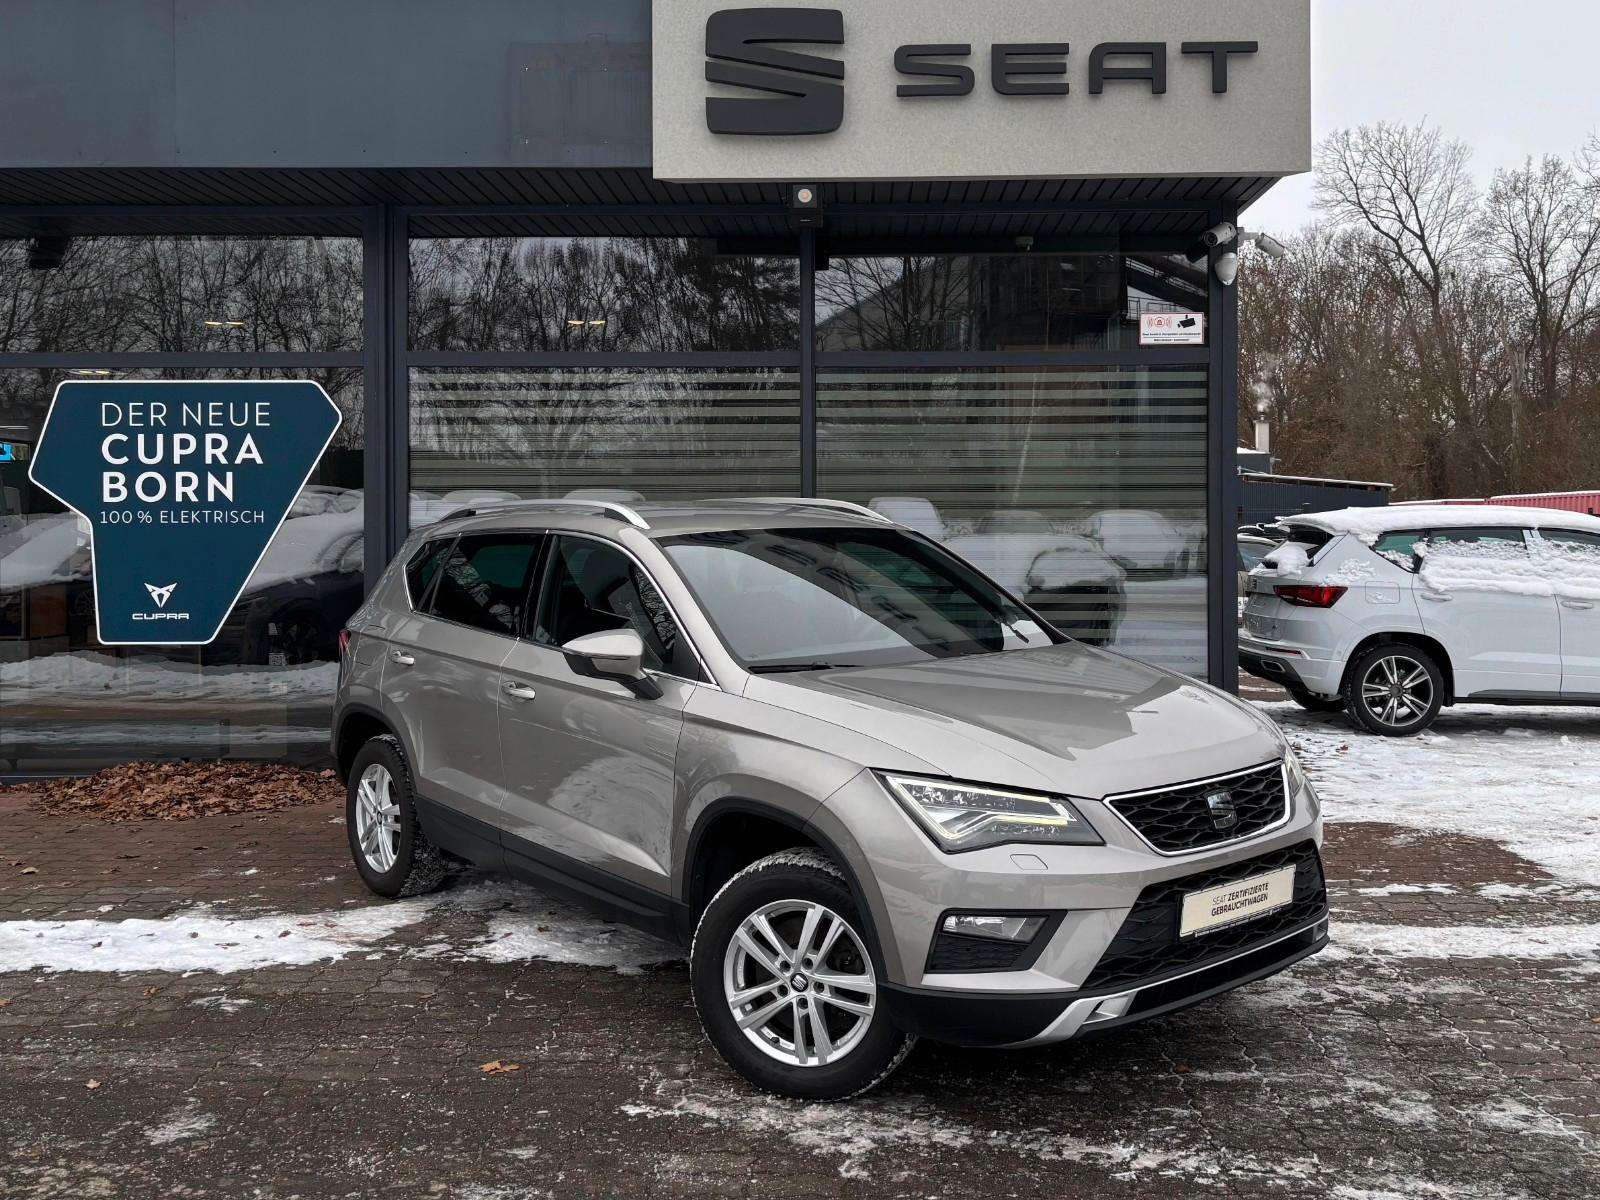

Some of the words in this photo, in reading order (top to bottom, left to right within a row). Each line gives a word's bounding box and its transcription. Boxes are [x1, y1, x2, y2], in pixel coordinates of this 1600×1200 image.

[894, 41, 1259, 97] SEAT
[101, 402, 167, 427] DER
[182, 401, 271, 427] NEUE
[101, 433, 264, 465] CUPRA
[102, 471, 235, 503] BORN
[100, 510, 133, 524] 100
[137, 510, 153, 524] %
[160, 510, 265, 524] ELEKTRISCH
[132, 612, 190, 620] CUPRA
[1211, 892, 1269, 917] GEBRAUCHTWAGEN
[1212, 894, 1227, 906] SEAT
[1227, 882, 1269, 902] ZERTIFIZIERTE
